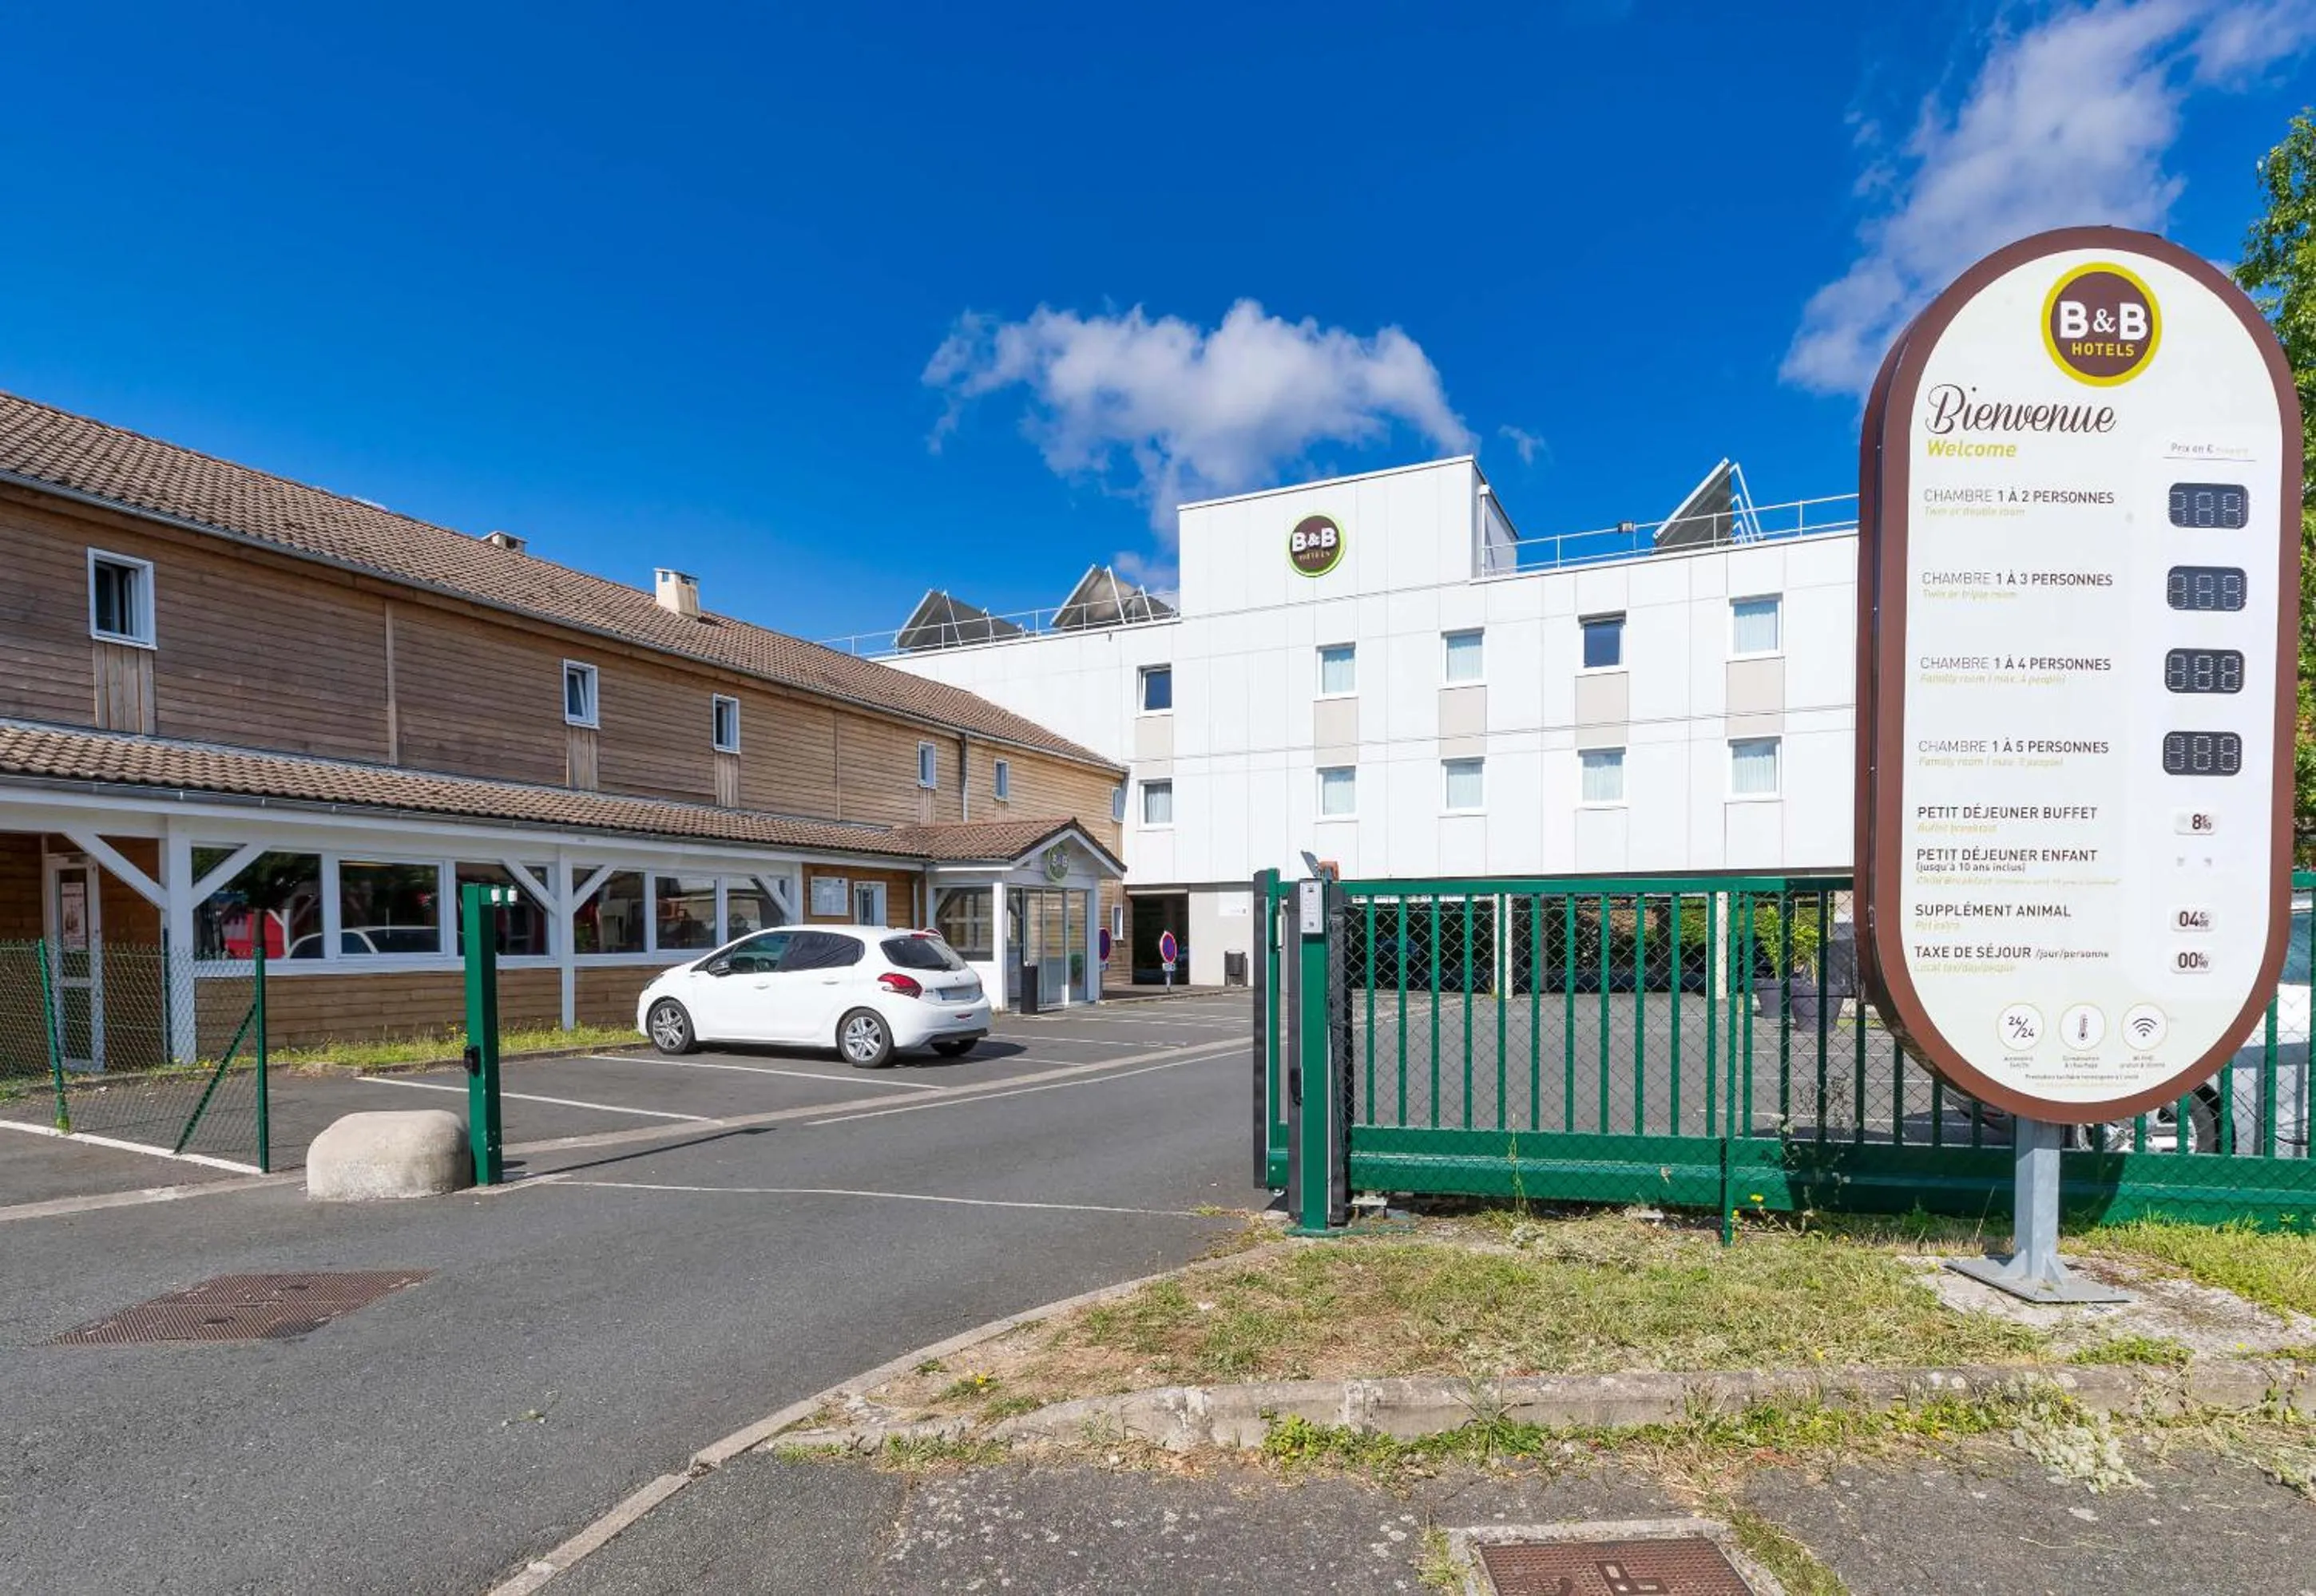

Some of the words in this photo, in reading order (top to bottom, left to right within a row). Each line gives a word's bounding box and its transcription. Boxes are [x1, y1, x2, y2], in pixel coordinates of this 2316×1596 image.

[2060, 300, 2148, 340] B&B
[2072, 343, 2135, 356] HOTELS
[1925, 383, 2116, 434] Bienvenue
[1927, 440, 2017, 457] Welcome
[1924, 489, 1993, 502] CHAMBRE
[1998, 490, 2004, 502] 1
[2022, 490, 2030, 502] 2
[2033, 490, 2115, 504] PERSONNES
[1291, 527, 1336, 552] B&B
[1922, 572, 1991, 584] CHAMBRE
[1996, 573, 2002, 584] 1
[2021, 573, 2028, 584] 3
[2032, 573, 2113, 586] PERSONNES
[1920, 656, 1989, 669] CHAMBRE
[1994, 657, 2000, 669] 1
[2018, 657, 2026, 669] 4
[2029, 657, 2111, 671] PERSONNES
[1918, 740, 1987, 753] CHAMBRE
[1993, 741, 1998, 752] 1
[2017, 741, 2024, 752] 5
[2028, 741, 2109, 754] PERSONNES
[1917, 806, 1957, 818] PETIT
[1963, 803, 2038, 819] DÉJEUNER
[2043, 806, 2098, 820] BUFFET
[1917, 848, 1957, 861] PETIT
[1961, 846, 2037, 861] DÉJEUNER
[2041, 849, 2098, 862] ENFANT
[1959, 863, 1970, 872] 10
[1915, 901, 2012, 917] SUPPLÉMENT
[2016, 905, 2072, 917] ANIMAL
[1914, 946, 1949, 958] TAXE
[1954, 946, 1972, 958] DE
[1977, 943, 2031, 958] SÉJOUR
